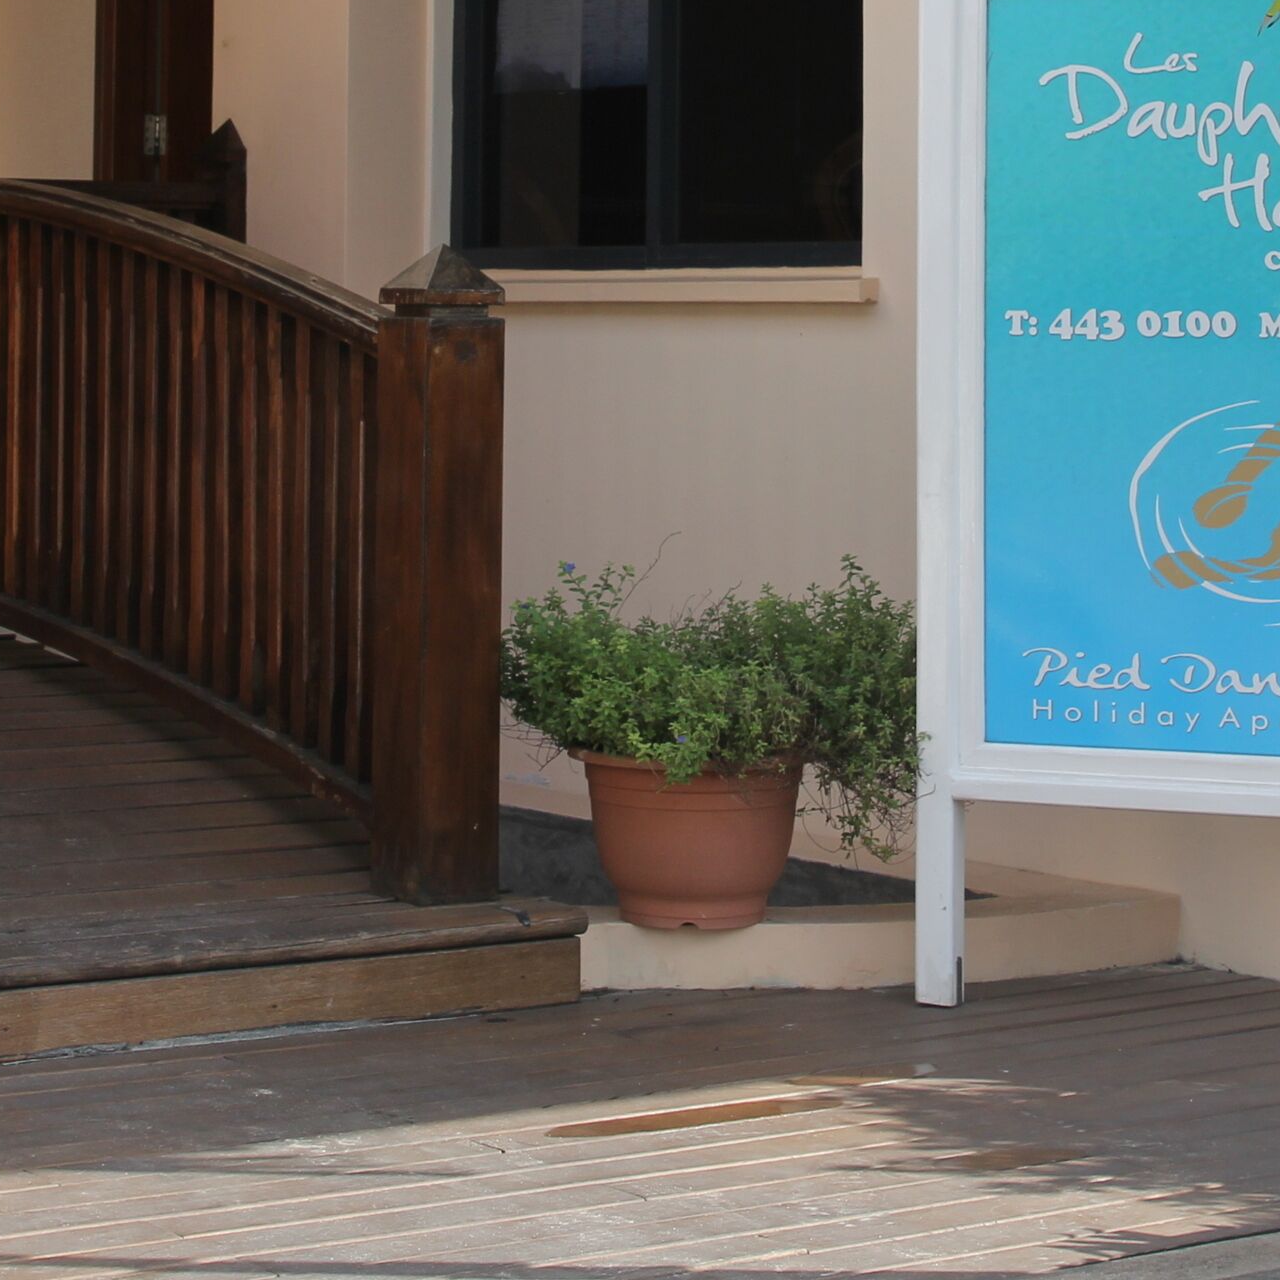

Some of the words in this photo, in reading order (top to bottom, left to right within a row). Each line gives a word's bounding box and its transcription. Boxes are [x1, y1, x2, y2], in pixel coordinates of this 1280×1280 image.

[1122, 31, 1199, 75] Les
[1004, 308, 1039, 337] T:
[1048, 308, 1126, 342] 443
[1136, 309, 1238, 339] 0100
[1022, 647, 1151, 691] Pied
[1031, 698, 1201, 734] Holiday
